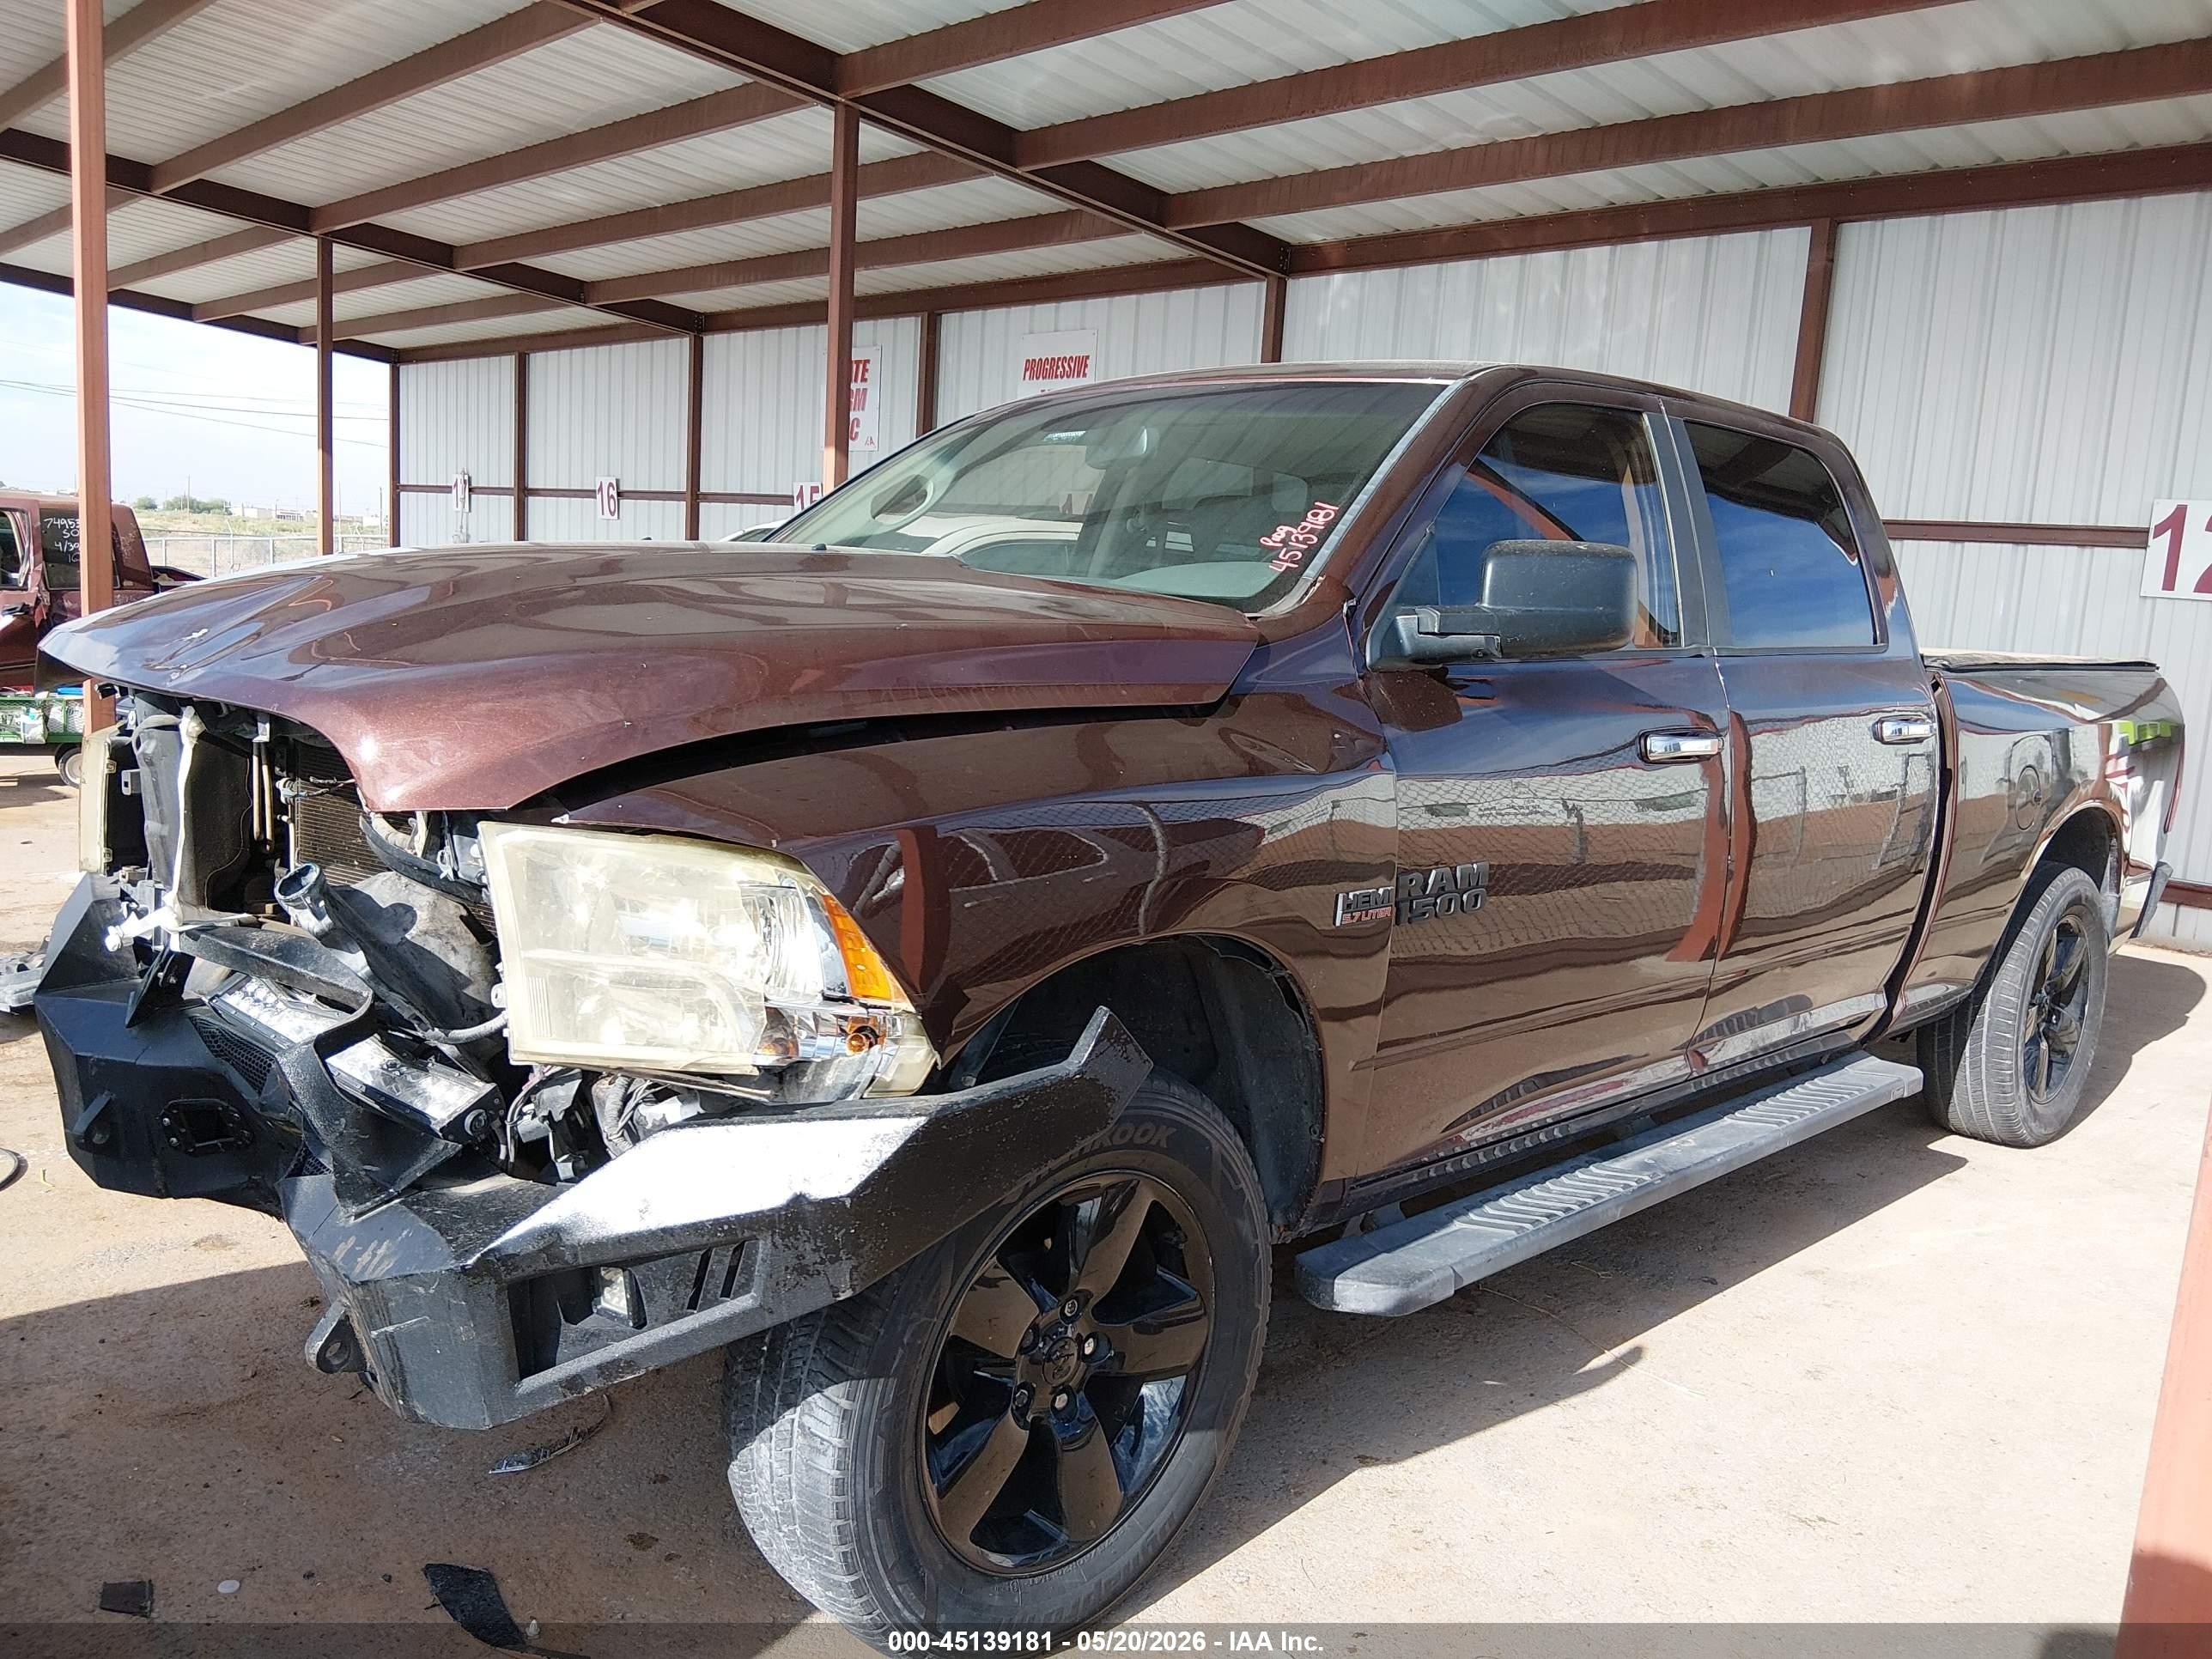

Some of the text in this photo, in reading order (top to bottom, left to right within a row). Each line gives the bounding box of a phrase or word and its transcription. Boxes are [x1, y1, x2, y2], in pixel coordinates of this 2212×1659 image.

[851, 359, 871, 383] TE
[1023, 355, 1091, 381] PROGRESSIVE
[597, 480, 617, 517] 16
[1268, 501, 1340, 572] 45139181
[1396, 861, 1490, 902] RAM
[1341, 906, 1393, 925] 5.7 LITER
[1395, 888, 1487, 926] 1500
